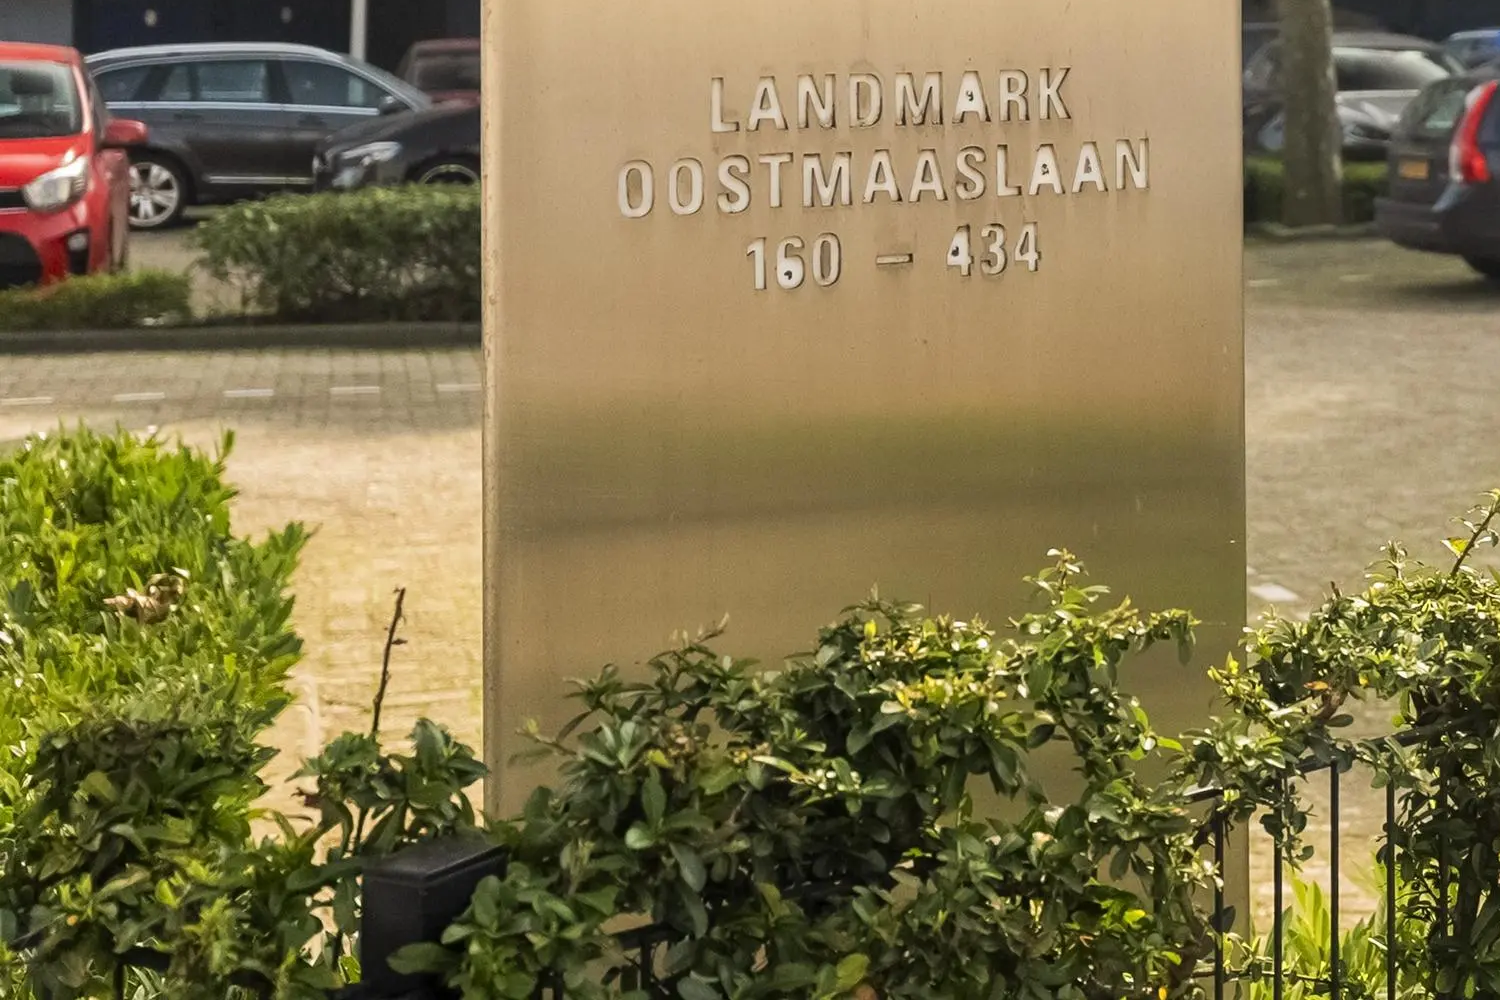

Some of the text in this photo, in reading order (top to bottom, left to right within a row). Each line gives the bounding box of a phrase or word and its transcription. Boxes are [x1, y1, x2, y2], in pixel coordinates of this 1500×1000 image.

[711, 67, 1071, 132] LANDMARK
[617, 138, 1150, 217] OOSTMAASLAAN
[746, 232, 841, 290] 160
[946, 222, 1042, 277] 434
